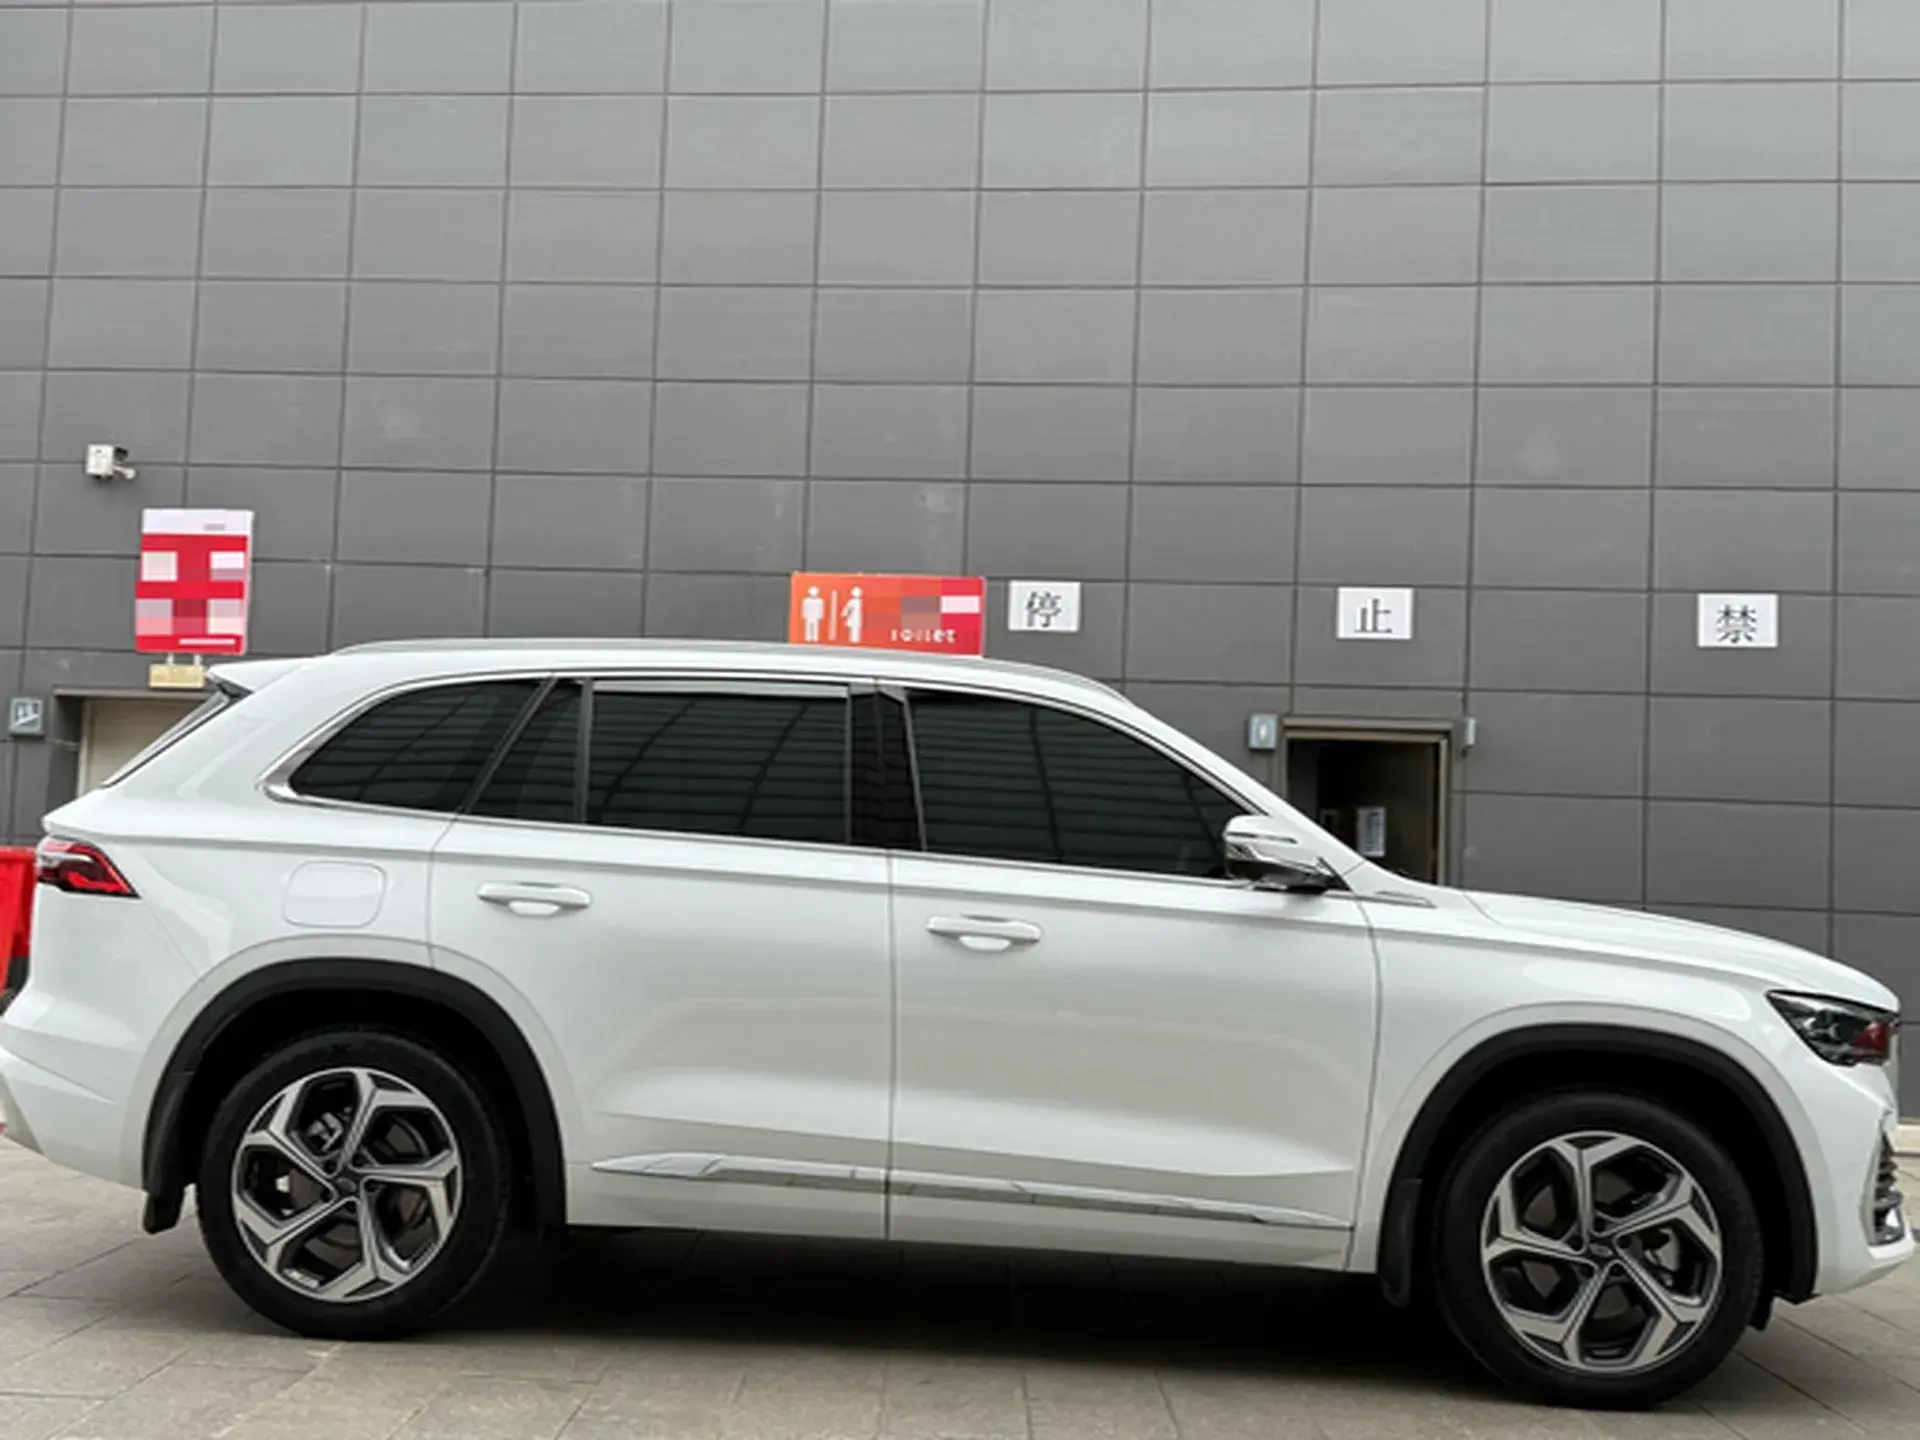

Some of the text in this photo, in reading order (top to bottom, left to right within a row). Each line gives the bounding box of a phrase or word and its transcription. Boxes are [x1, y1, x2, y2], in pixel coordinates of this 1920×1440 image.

[1026, 591, 1062, 628] 停
[1355, 598, 1393, 634] 止
[1716, 604, 1757, 644] 禁
